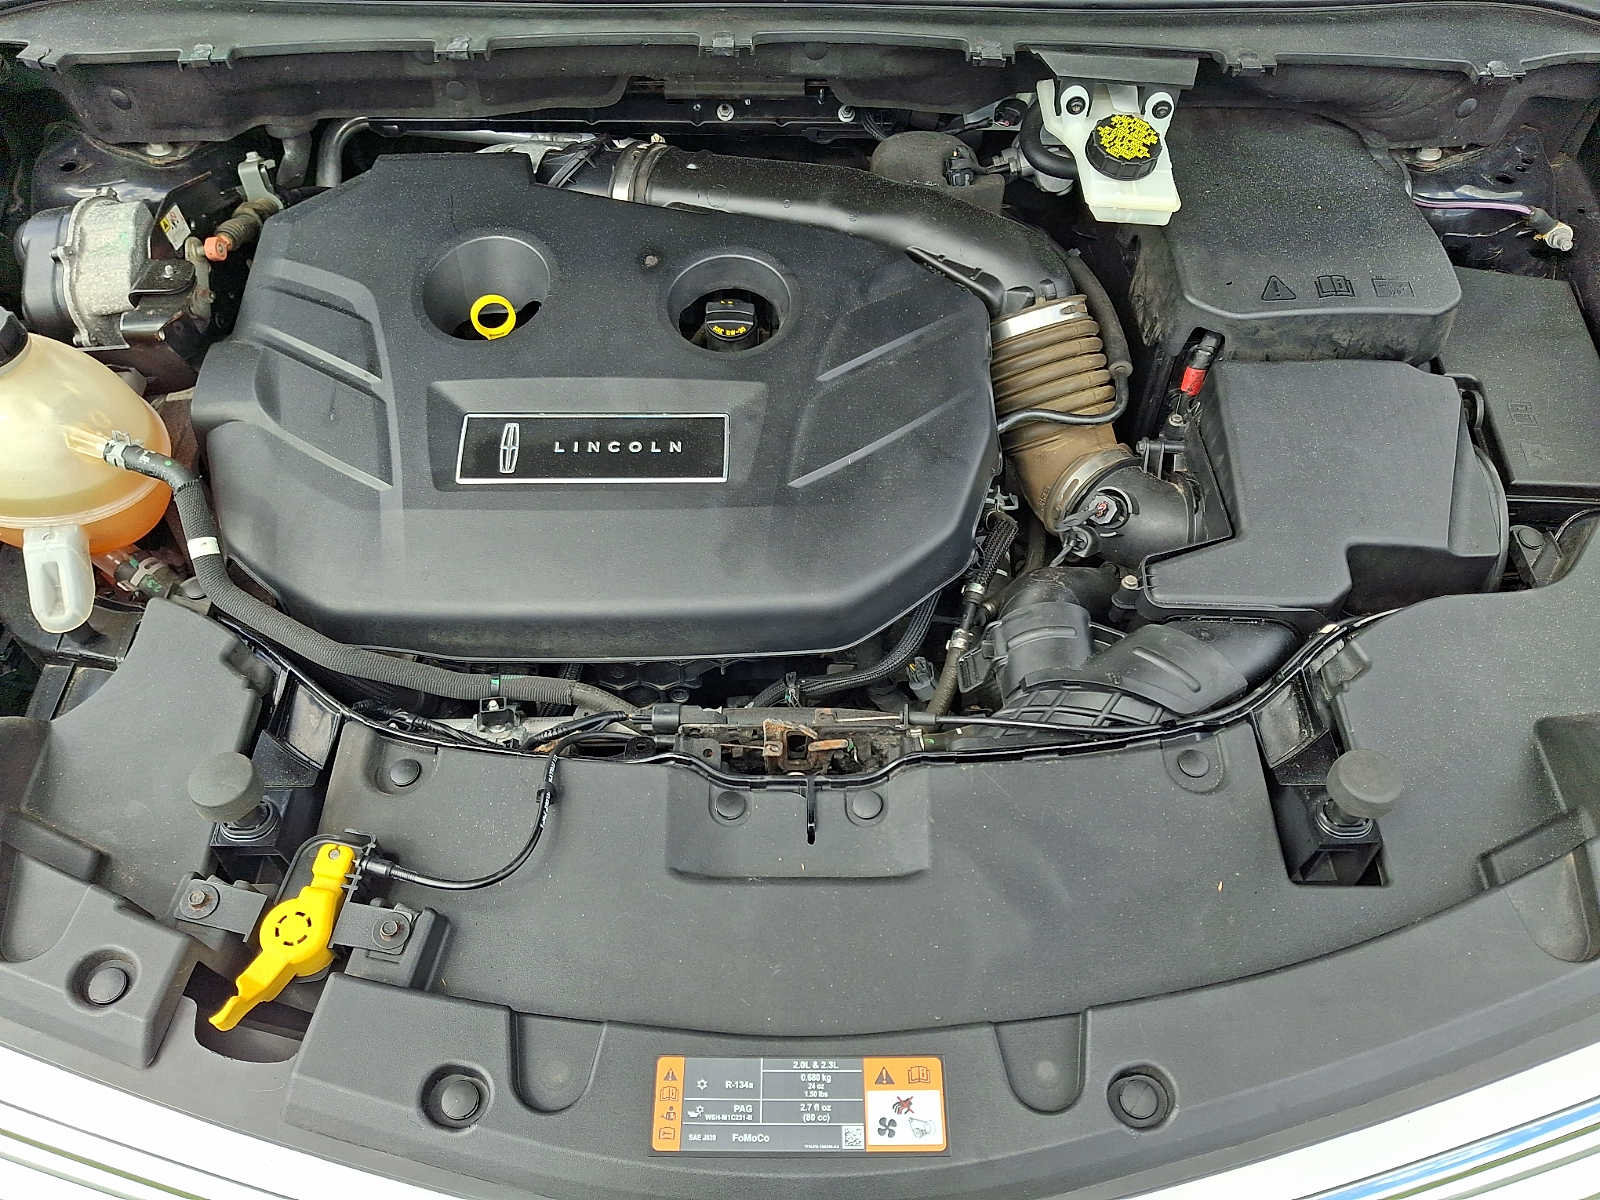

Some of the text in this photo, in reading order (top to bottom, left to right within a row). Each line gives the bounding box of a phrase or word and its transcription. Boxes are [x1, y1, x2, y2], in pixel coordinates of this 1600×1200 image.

[554, 441, 684, 453] LINCOLN
[792, 1060, 839, 1069] 2.0L & 2.3L
[821, 1073, 832, 1084] kg
[725, 1080, 754, 1089] R-134a
[733, 1104, 753, 1113] PAG
[800, 1103, 813, 1112] 2.7
[821, 1104, 832, 1112] oz
[816, 1112, 831, 1123] cc)
[731, 1133, 771, 1143] FoMoCo
